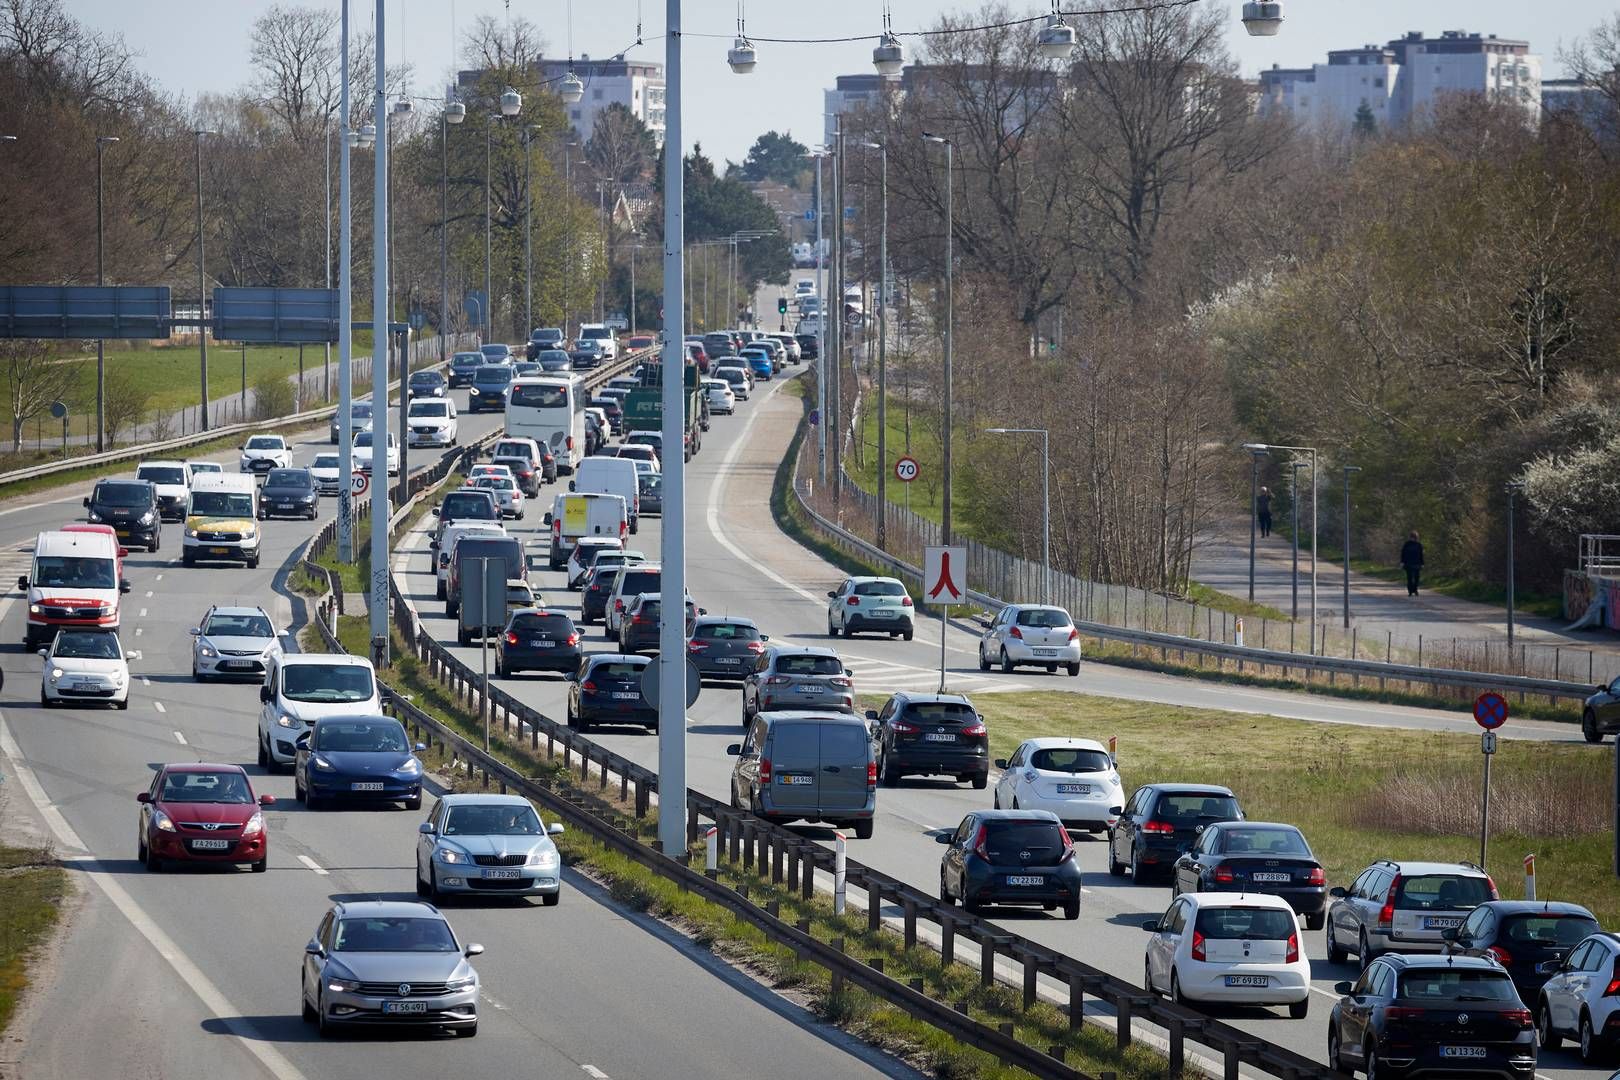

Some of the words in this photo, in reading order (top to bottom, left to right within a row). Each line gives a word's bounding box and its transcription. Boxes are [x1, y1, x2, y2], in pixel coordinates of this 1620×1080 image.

[900, 464, 915, 475] 70
[507, 870, 518, 878] 200
[1021, 876, 1029, 884] 22
[1440, 919, 1449, 927] 79
[1243, 976, 1251, 985] 69
[1253, 976, 1266, 985] 837
[400, 1003, 409, 1012] 56
[1458, 1048, 1468, 1057] 13
